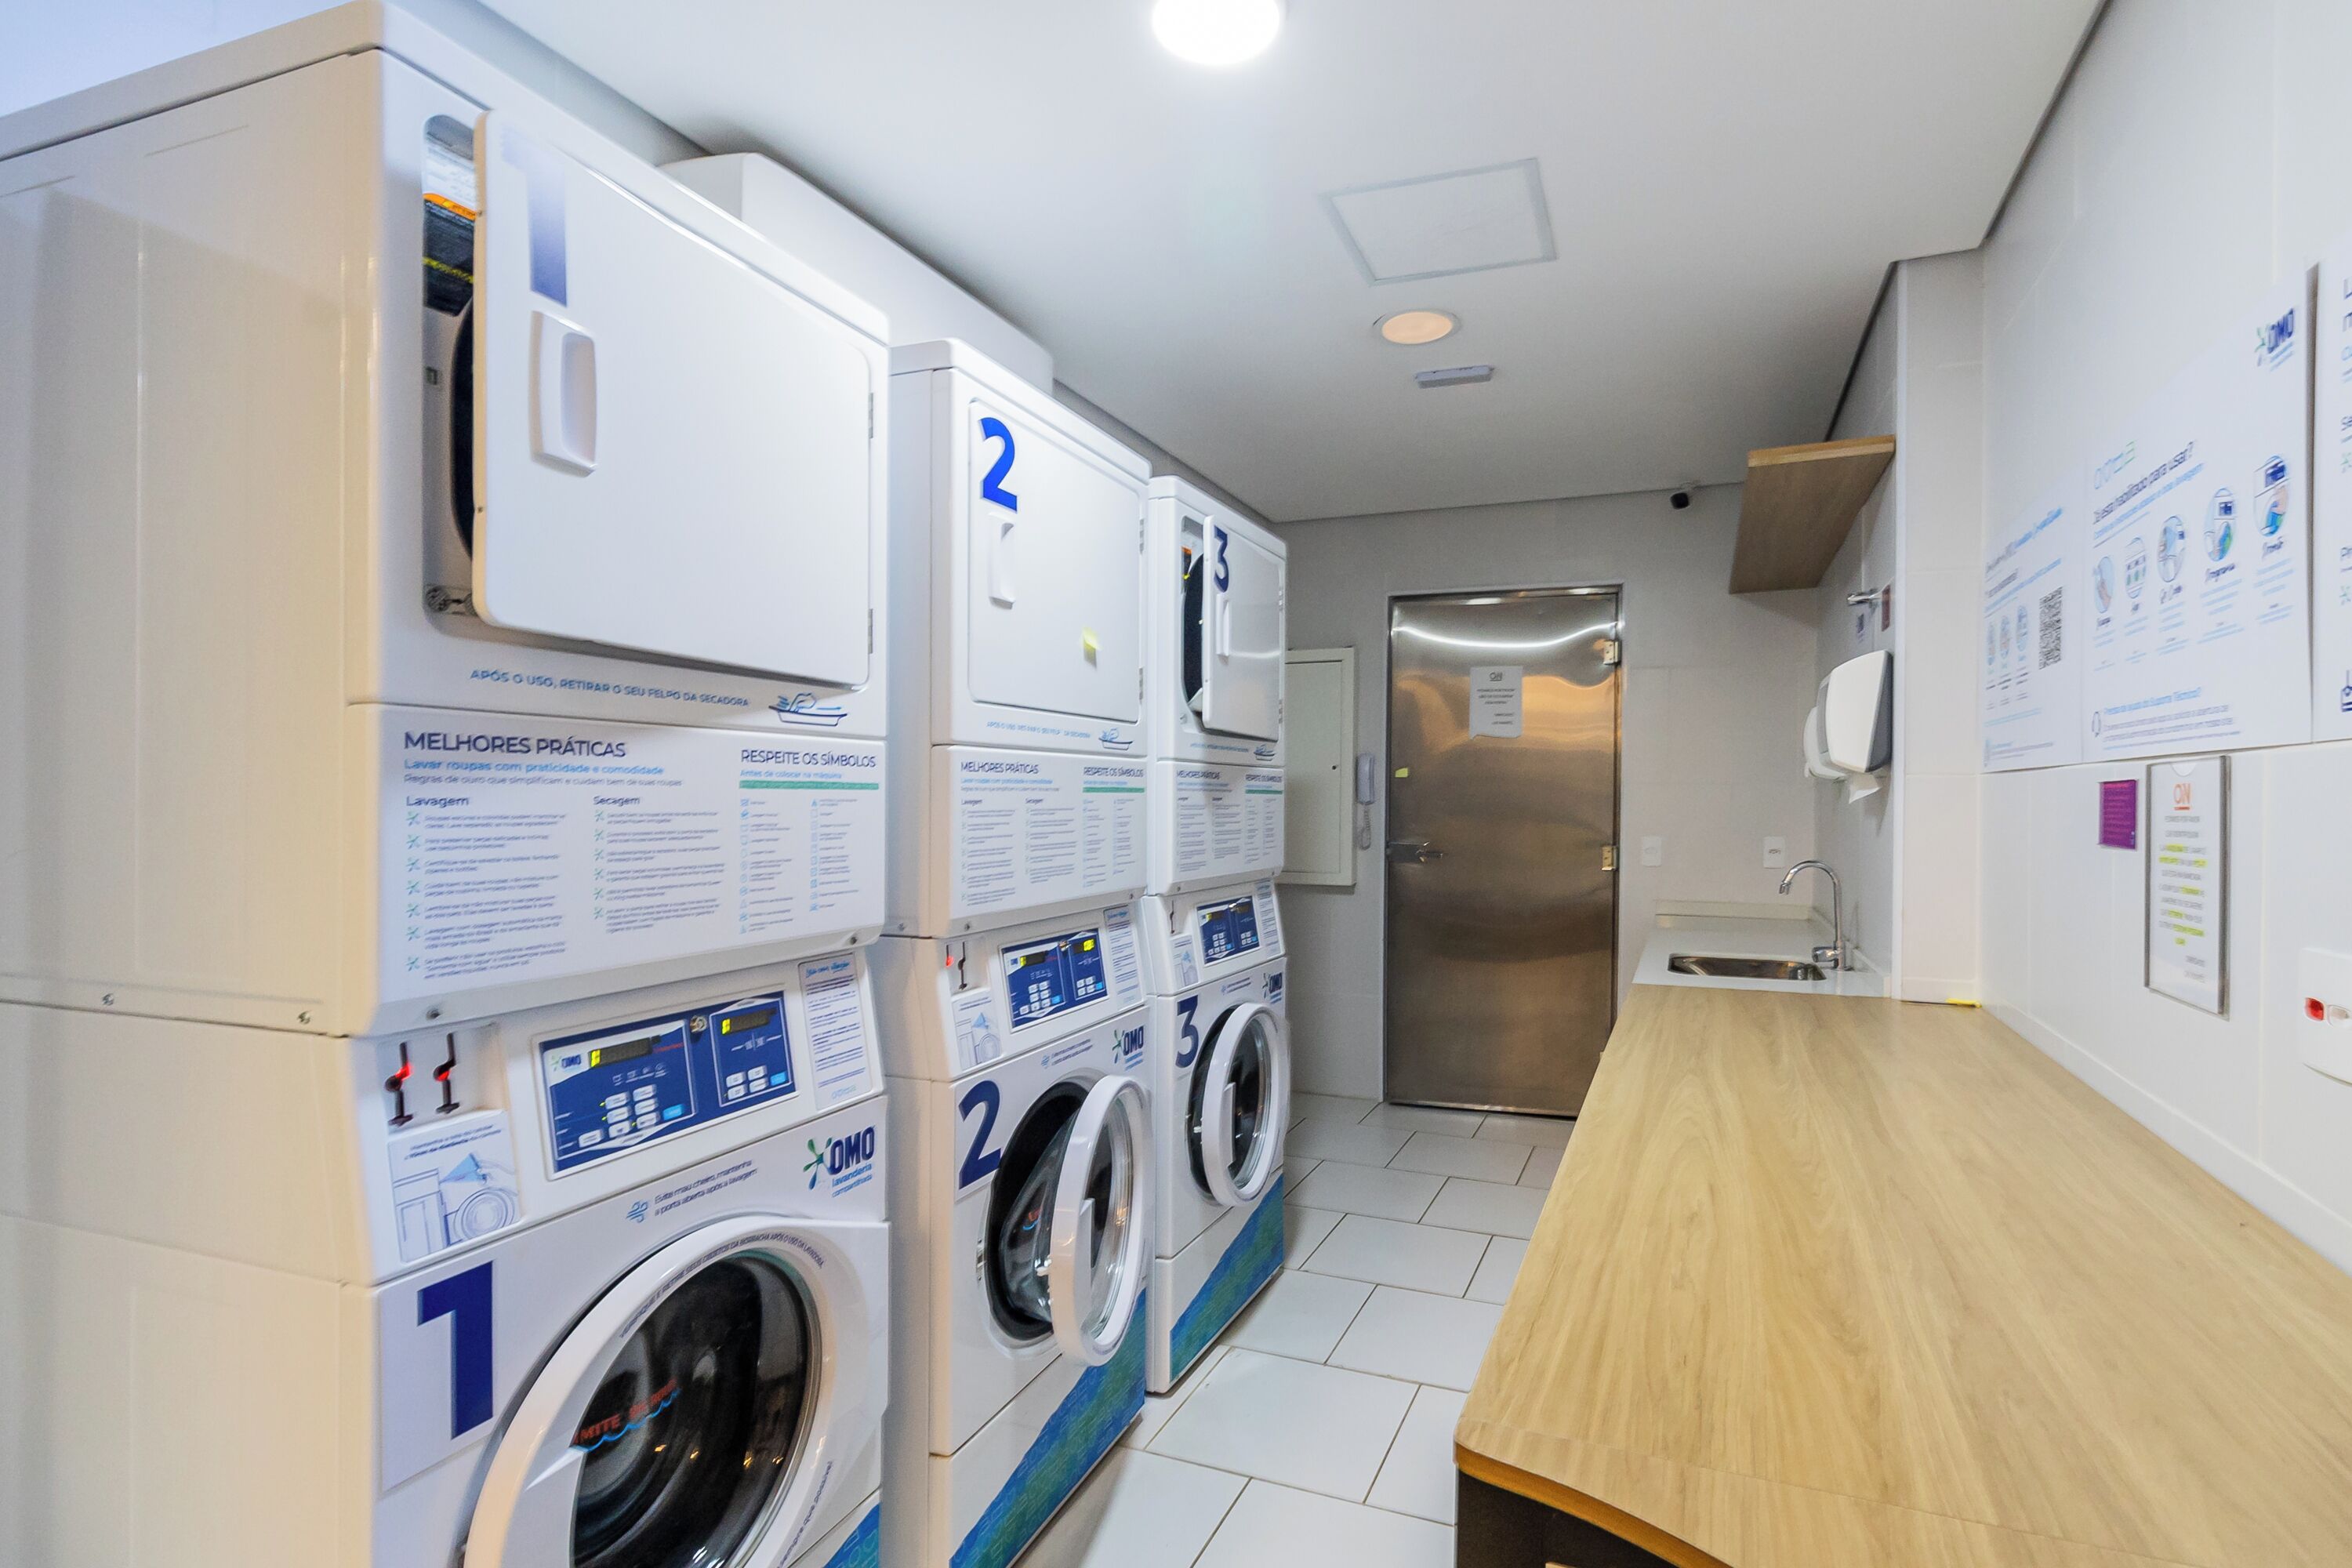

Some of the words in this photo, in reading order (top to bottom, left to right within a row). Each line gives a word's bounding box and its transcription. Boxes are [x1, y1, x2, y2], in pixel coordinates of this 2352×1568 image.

[978, 416, 1018, 514] 2
[1214, 524, 1230, 593] 3
[470, 670, 510, 682] APÓS
[513, 673, 523, 684] O
[526, 675, 557, 688] USO,
[559, 678, 610, 692] RETIRAR
[612, 684, 622, 694] O
[624, 685, 645, 697] SEU
[684, 691, 697, 701] DA
[699, 695, 749, 706] SECADORA
[404, 731, 532, 754] MELHORES
[535, 735, 626, 757] PRÁTICAS
[741, 749, 800, 764] RESPEITE
[802, 753, 818, 765] OS
[821, 751, 877, 768] SÍMBOLOS
[404, 758, 442, 770] Lavar
[446, 760, 492, 772] roupas
[495, 763, 522, 771] com
[525, 761, 590, 773] praticidade
[405, 795, 470, 808] Lavagem
[593, 795, 641, 807] Secagem
[1123, 1025, 1144, 1056] OMO
[1176, 995, 1199, 1069] 3
[829, 1125, 875, 1176] OMO
[958, 1080, 1001, 1189] 2
[661, 1201, 681, 1216] porta
[418, 1260, 494, 1440] 1
